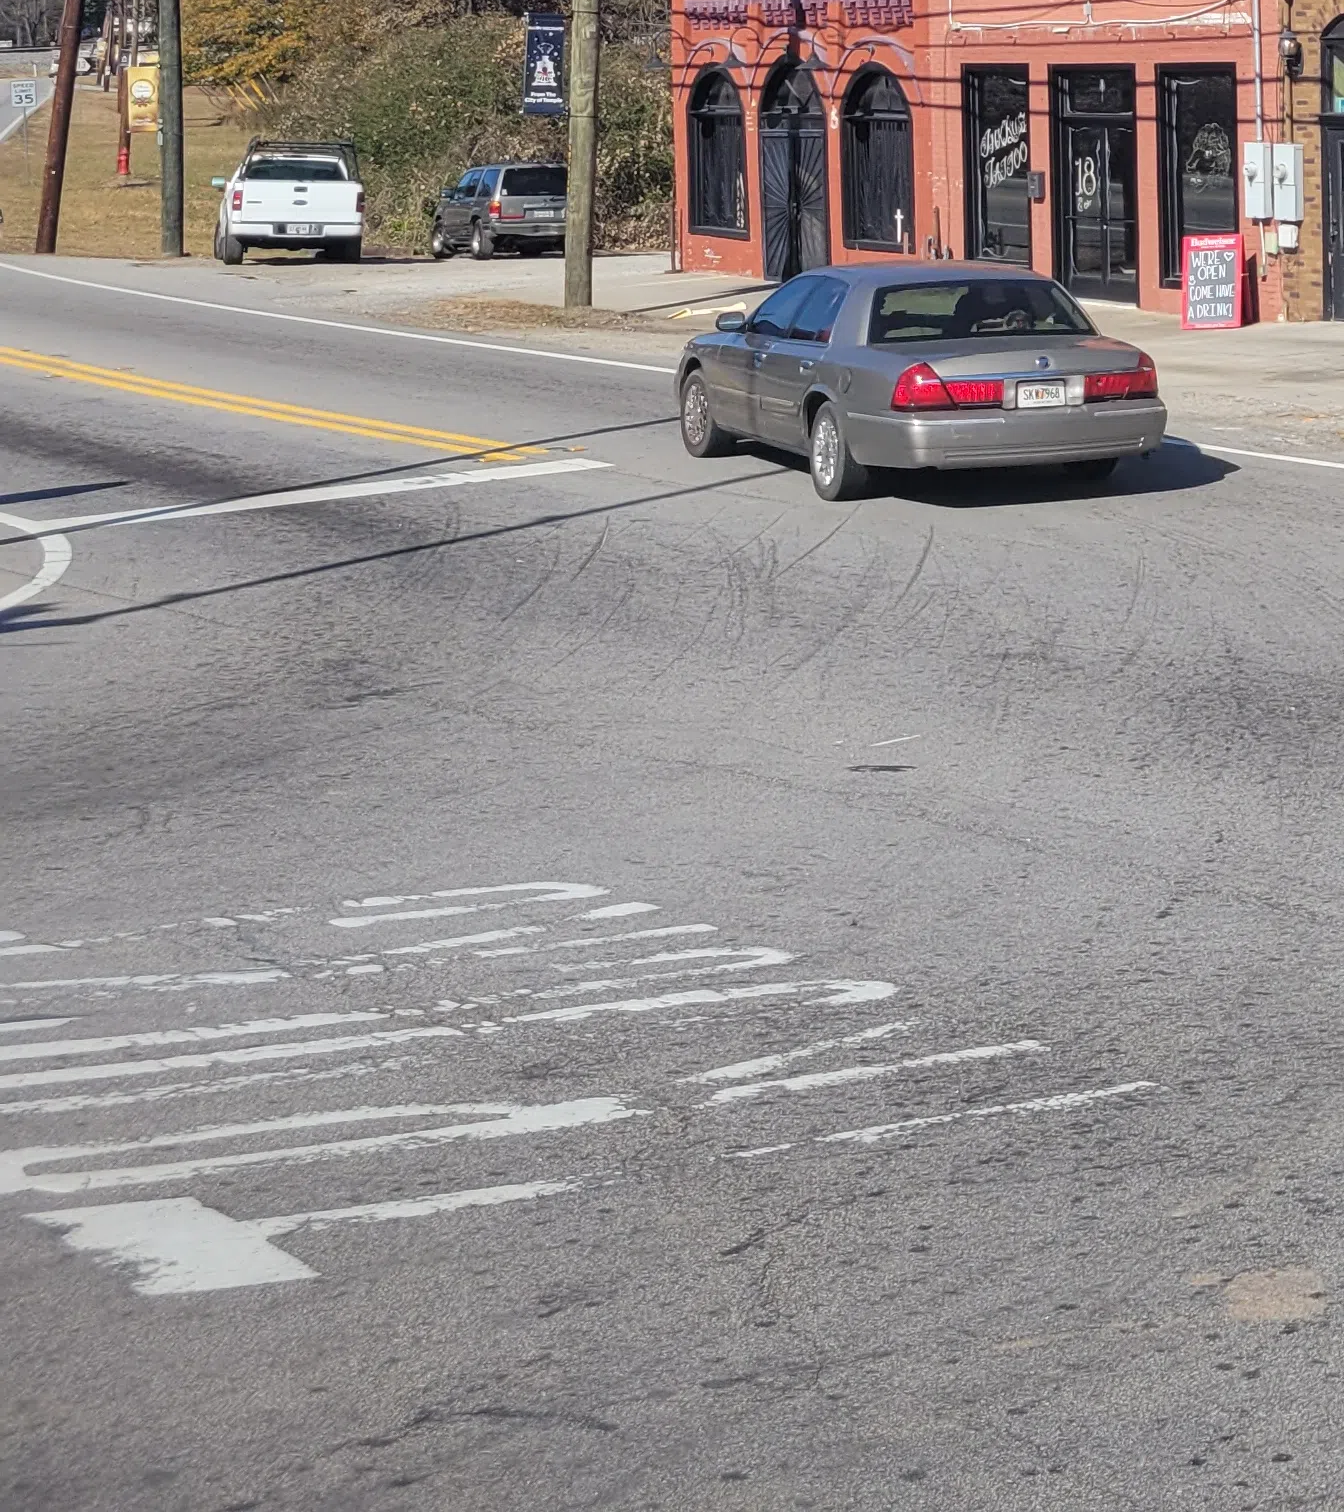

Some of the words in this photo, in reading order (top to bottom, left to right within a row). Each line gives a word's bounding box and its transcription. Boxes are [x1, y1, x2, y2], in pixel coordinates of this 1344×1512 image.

[14, 94, 34, 105] 35
[984, 141, 1028, 188] TATTOO
[1075, 156, 1096, 196] 18
[1190, 238, 1236, 247] Budweiser
[1197, 264, 1226, 281] OPEN
[1189, 285, 1215, 302] COME
[1215, 283, 1236, 298] HAVE
[1188, 305, 1195, 320] A
[1197, 302, 1233, 318] DRINK!
